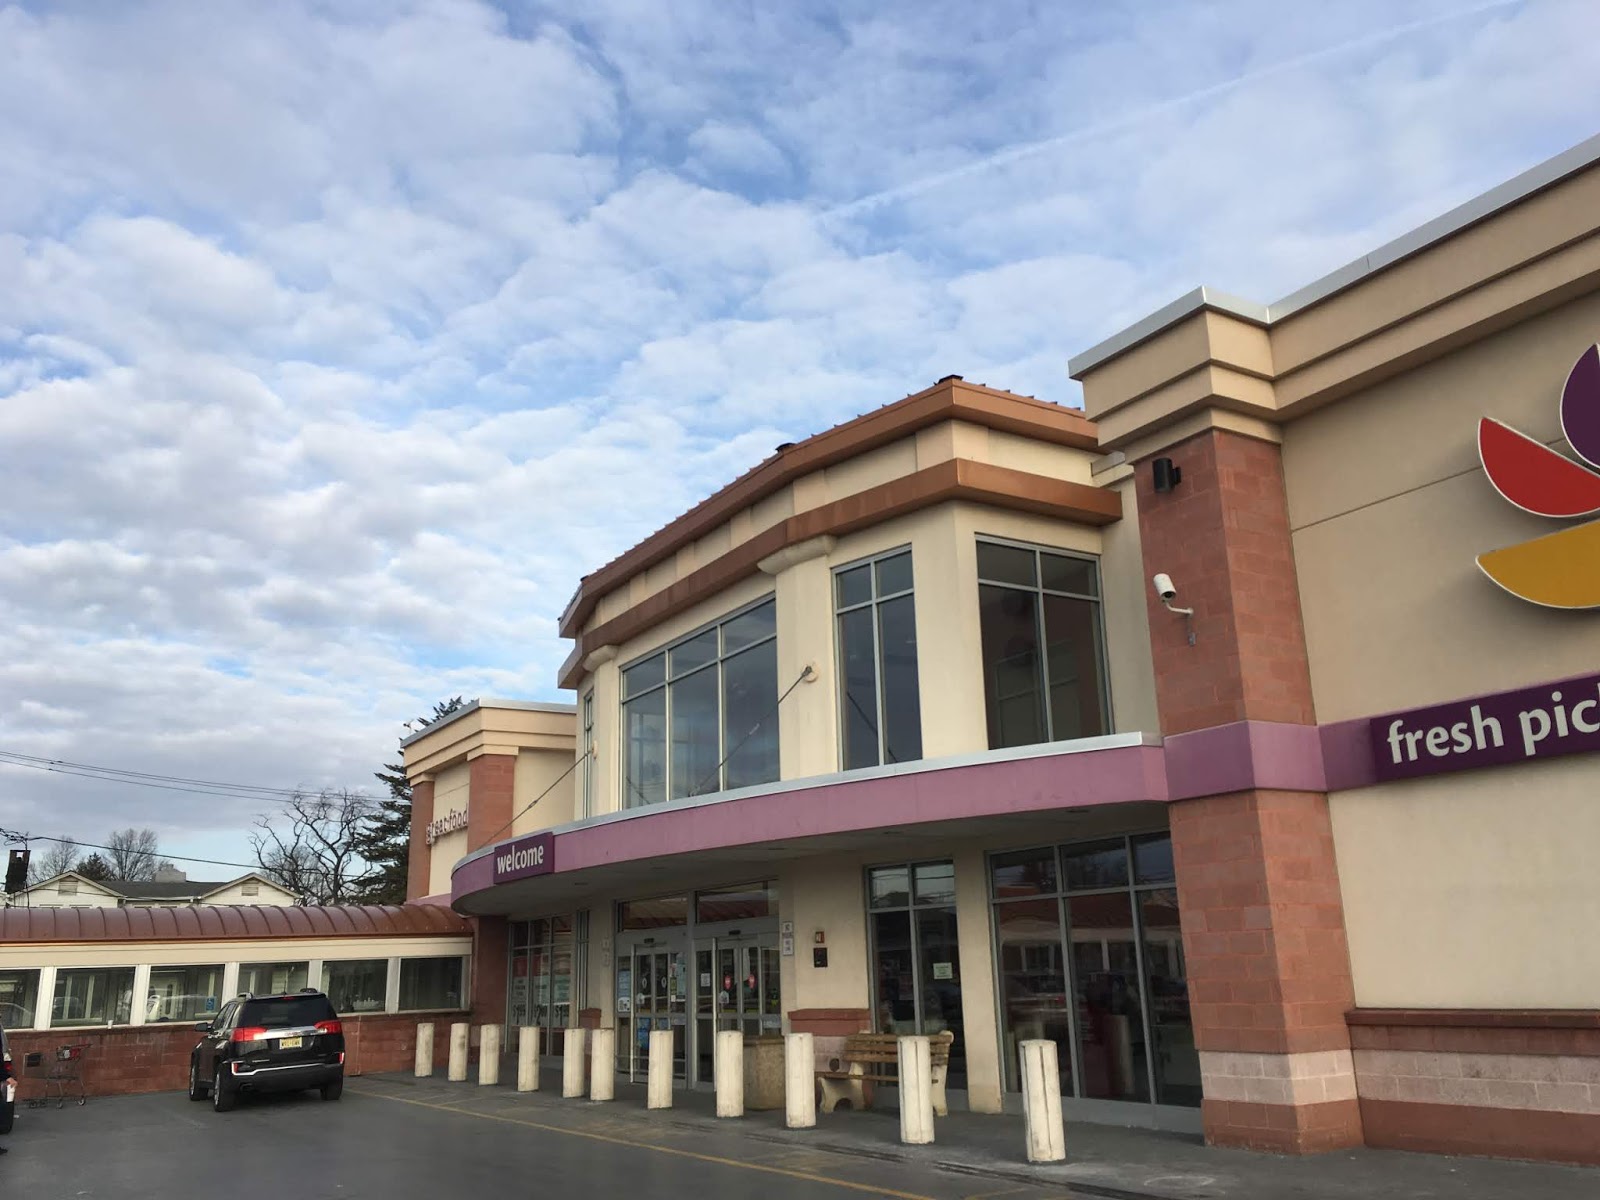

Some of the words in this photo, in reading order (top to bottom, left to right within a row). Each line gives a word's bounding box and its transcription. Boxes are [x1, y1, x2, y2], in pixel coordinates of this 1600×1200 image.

[1387, 704, 1505, 764] fresh
[1518, 682, 1600, 757] pic
[449, 802, 469, 831] food
[497, 845, 544, 874] welcome
